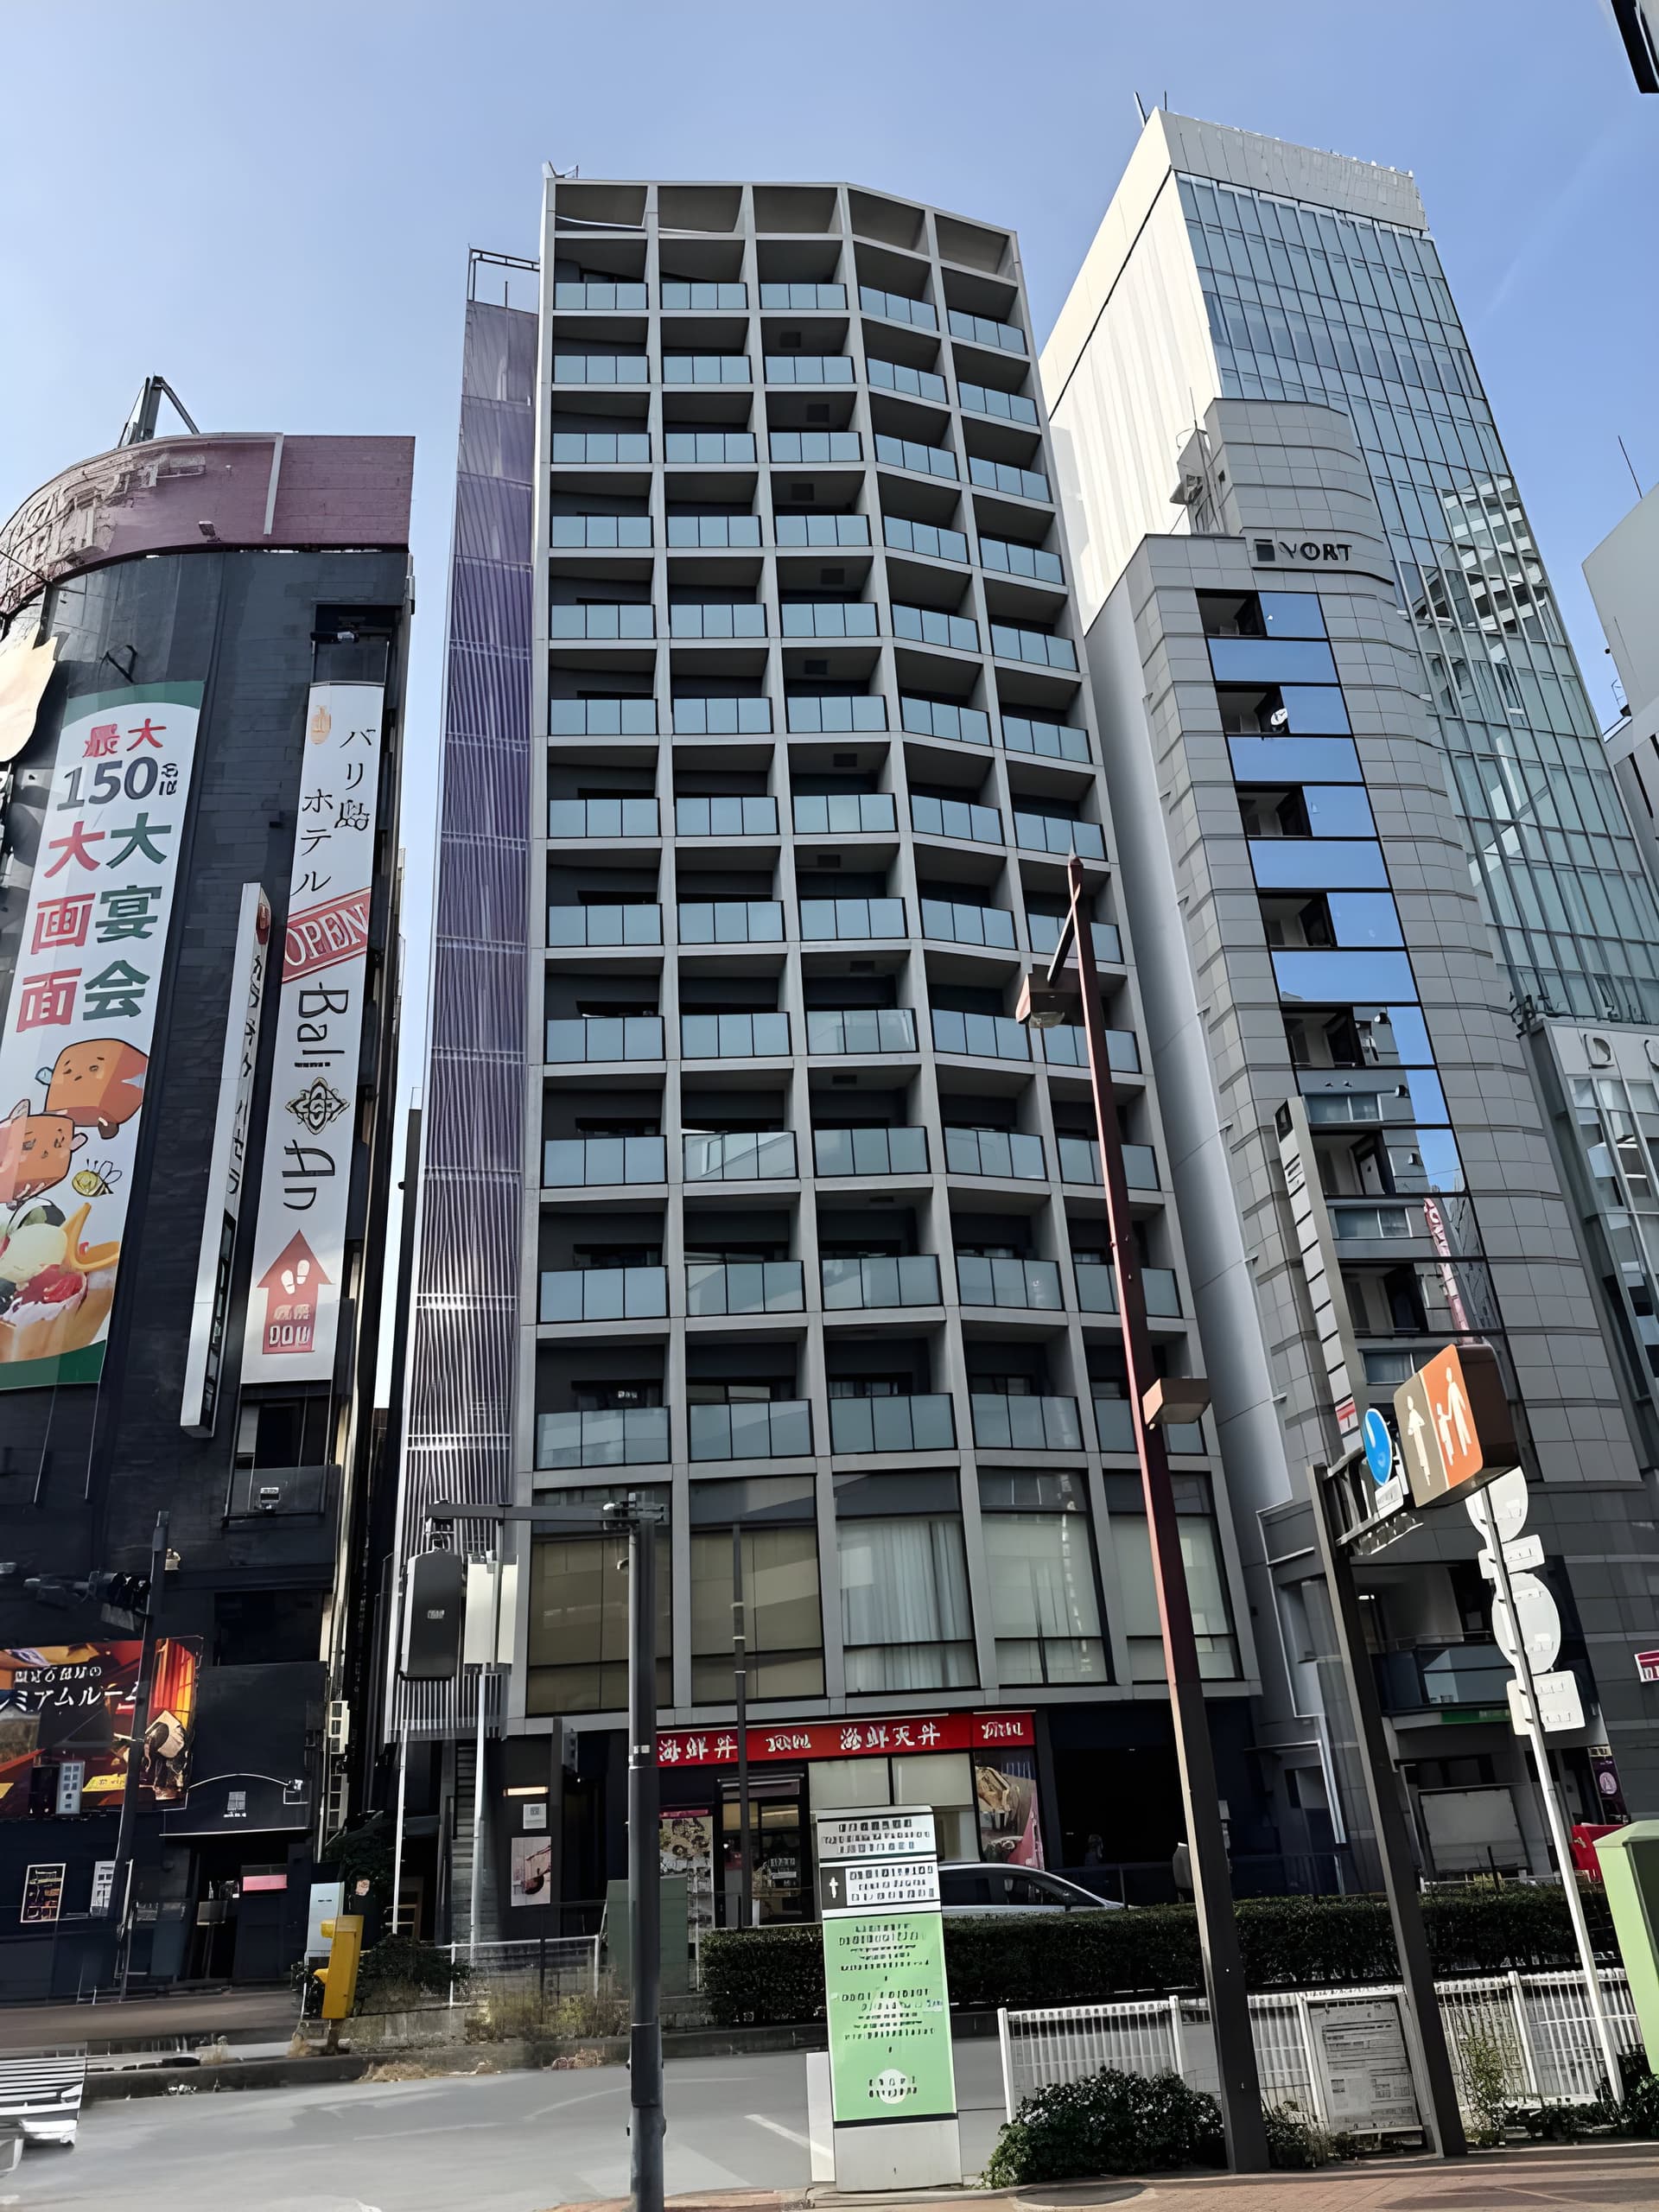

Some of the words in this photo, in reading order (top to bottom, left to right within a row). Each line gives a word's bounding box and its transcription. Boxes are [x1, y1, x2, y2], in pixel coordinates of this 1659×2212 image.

[83, 811, 172, 1021] 大宴会
[284, 903, 367, 967] OPEN
